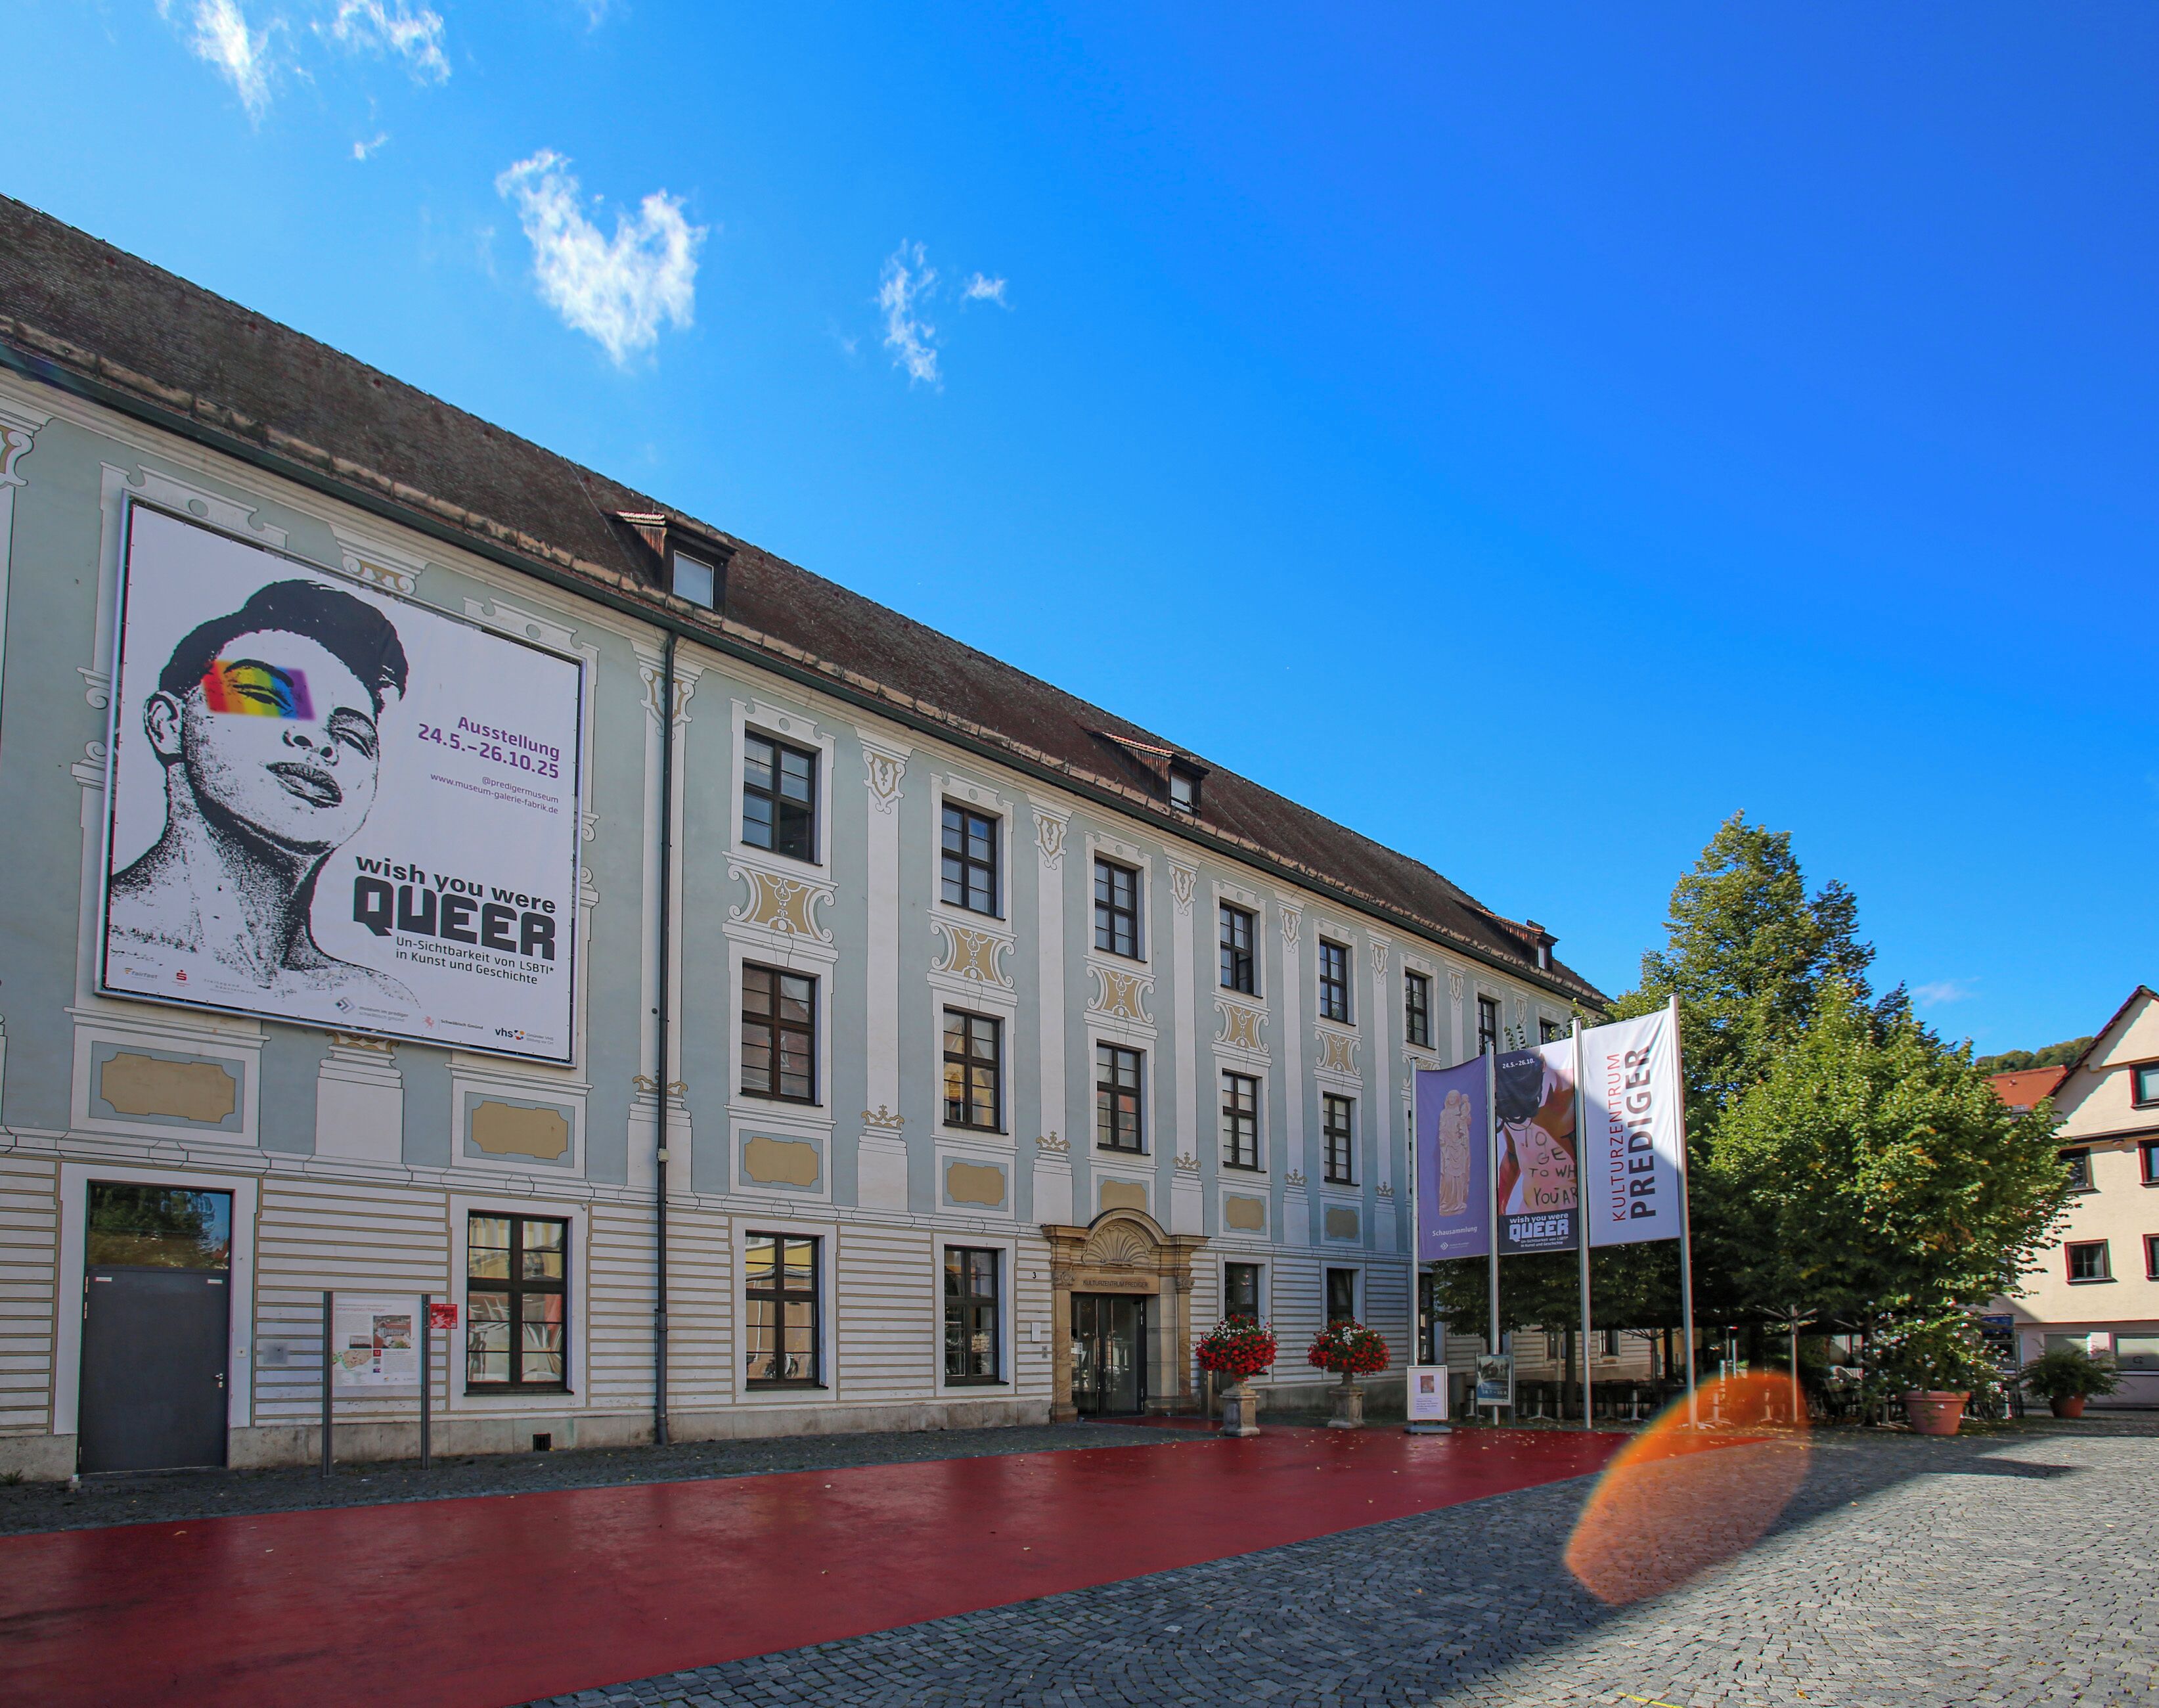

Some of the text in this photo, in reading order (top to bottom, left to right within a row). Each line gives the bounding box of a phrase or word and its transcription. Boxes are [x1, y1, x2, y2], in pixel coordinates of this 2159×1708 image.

[458, 717, 560, 761] Ausstellung
[430, 773, 558, 814] www.museum-galerie-fabrik.de
[482, 776, 558, 803] @predigermuseum
[355, 856, 556, 914] wish you were
[353, 876, 556, 961] QUEER
[396, 937, 489, 963] Un-Sichtbarkeit
[495, 956, 515, 968] von
[396, 949, 538, 985] in Kunst und Geschichte
[495, 1028, 514, 1037] vhs
[1607, 1053, 1626, 1221] KULTURZENTRUM
[1624, 1046, 1657, 1219] PREDIGER
[1534, 1187, 1559, 1206] YOU
[1432, 1226, 1478, 1236] Schausammlung
[1509, 1219, 1569, 1242] QUEER
